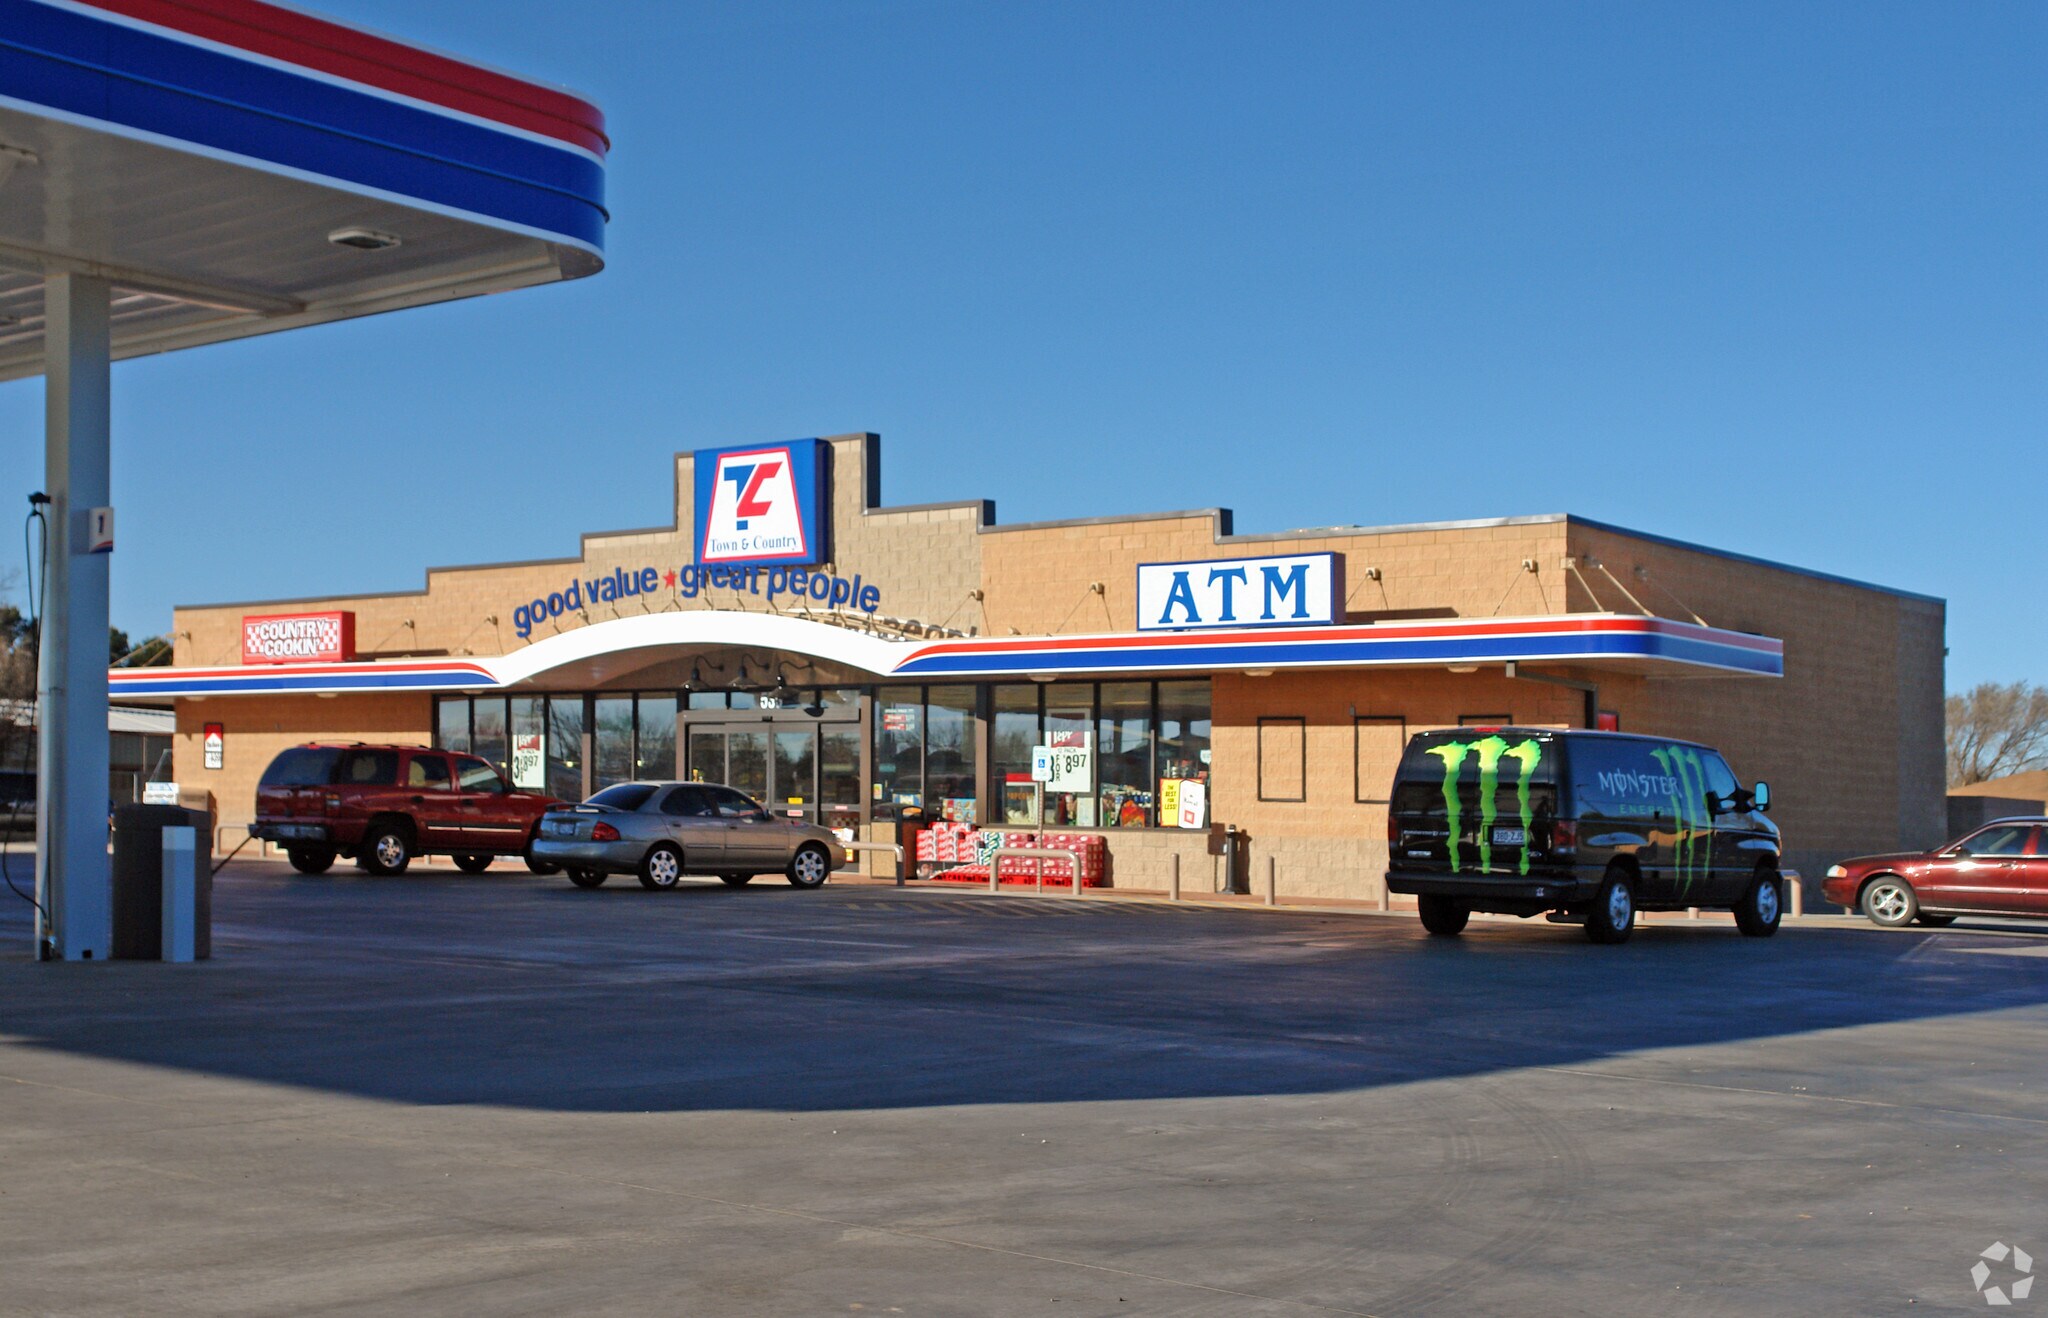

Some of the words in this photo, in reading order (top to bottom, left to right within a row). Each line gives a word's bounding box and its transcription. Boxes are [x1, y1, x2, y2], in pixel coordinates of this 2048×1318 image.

[97, 514, 104, 534] 1
[711, 538, 738, 552] Town
[741, 538, 749, 550] &
[753, 535, 797, 551] Country
[513, 578, 582, 638] good
[585, 566, 658, 601] value
[680, 562, 760, 598] great
[767, 565, 881, 613] people
[1158, 564, 1310, 624] ATM
[260, 619, 325, 640] COUNTRY
[264, 638, 319, 656] COOKIN'
[514, 756, 519, 779] 3
[1619, 803, 1675, 817] ENERGY
